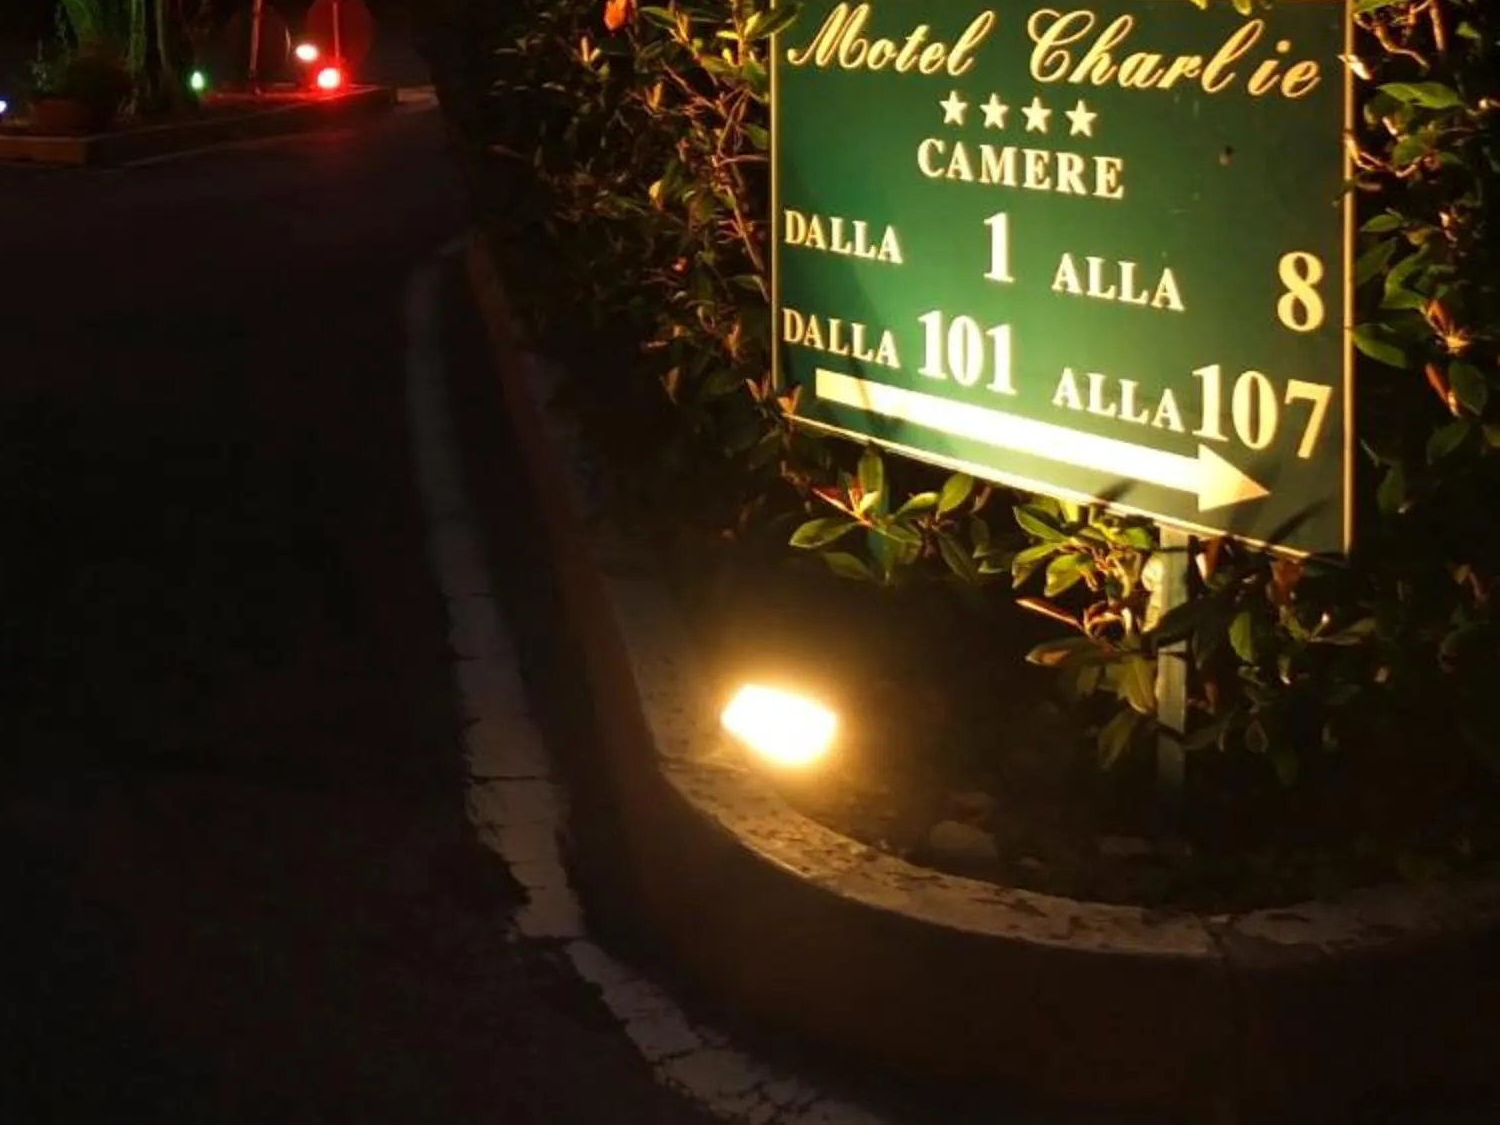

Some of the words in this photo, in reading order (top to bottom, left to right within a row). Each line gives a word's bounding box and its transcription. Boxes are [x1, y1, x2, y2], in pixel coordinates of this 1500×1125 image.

[787, 1, 996, 77] Motel
[1027, 9, 1321, 99] Charlie
[917, 137, 1124, 200] CAMERE
[784, 210, 903, 264] DALLA
[983, 212, 1015, 283] 1
[1050, 252, 1185, 312] ALLA
[1275, 250, 1324, 332] 8
[782, 308, 900, 369] DALLA
[916, 309, 1017, 396] 101
[1050, 367, 1184, 435] ALLA
[1191, 364, 1332, 460] 107
